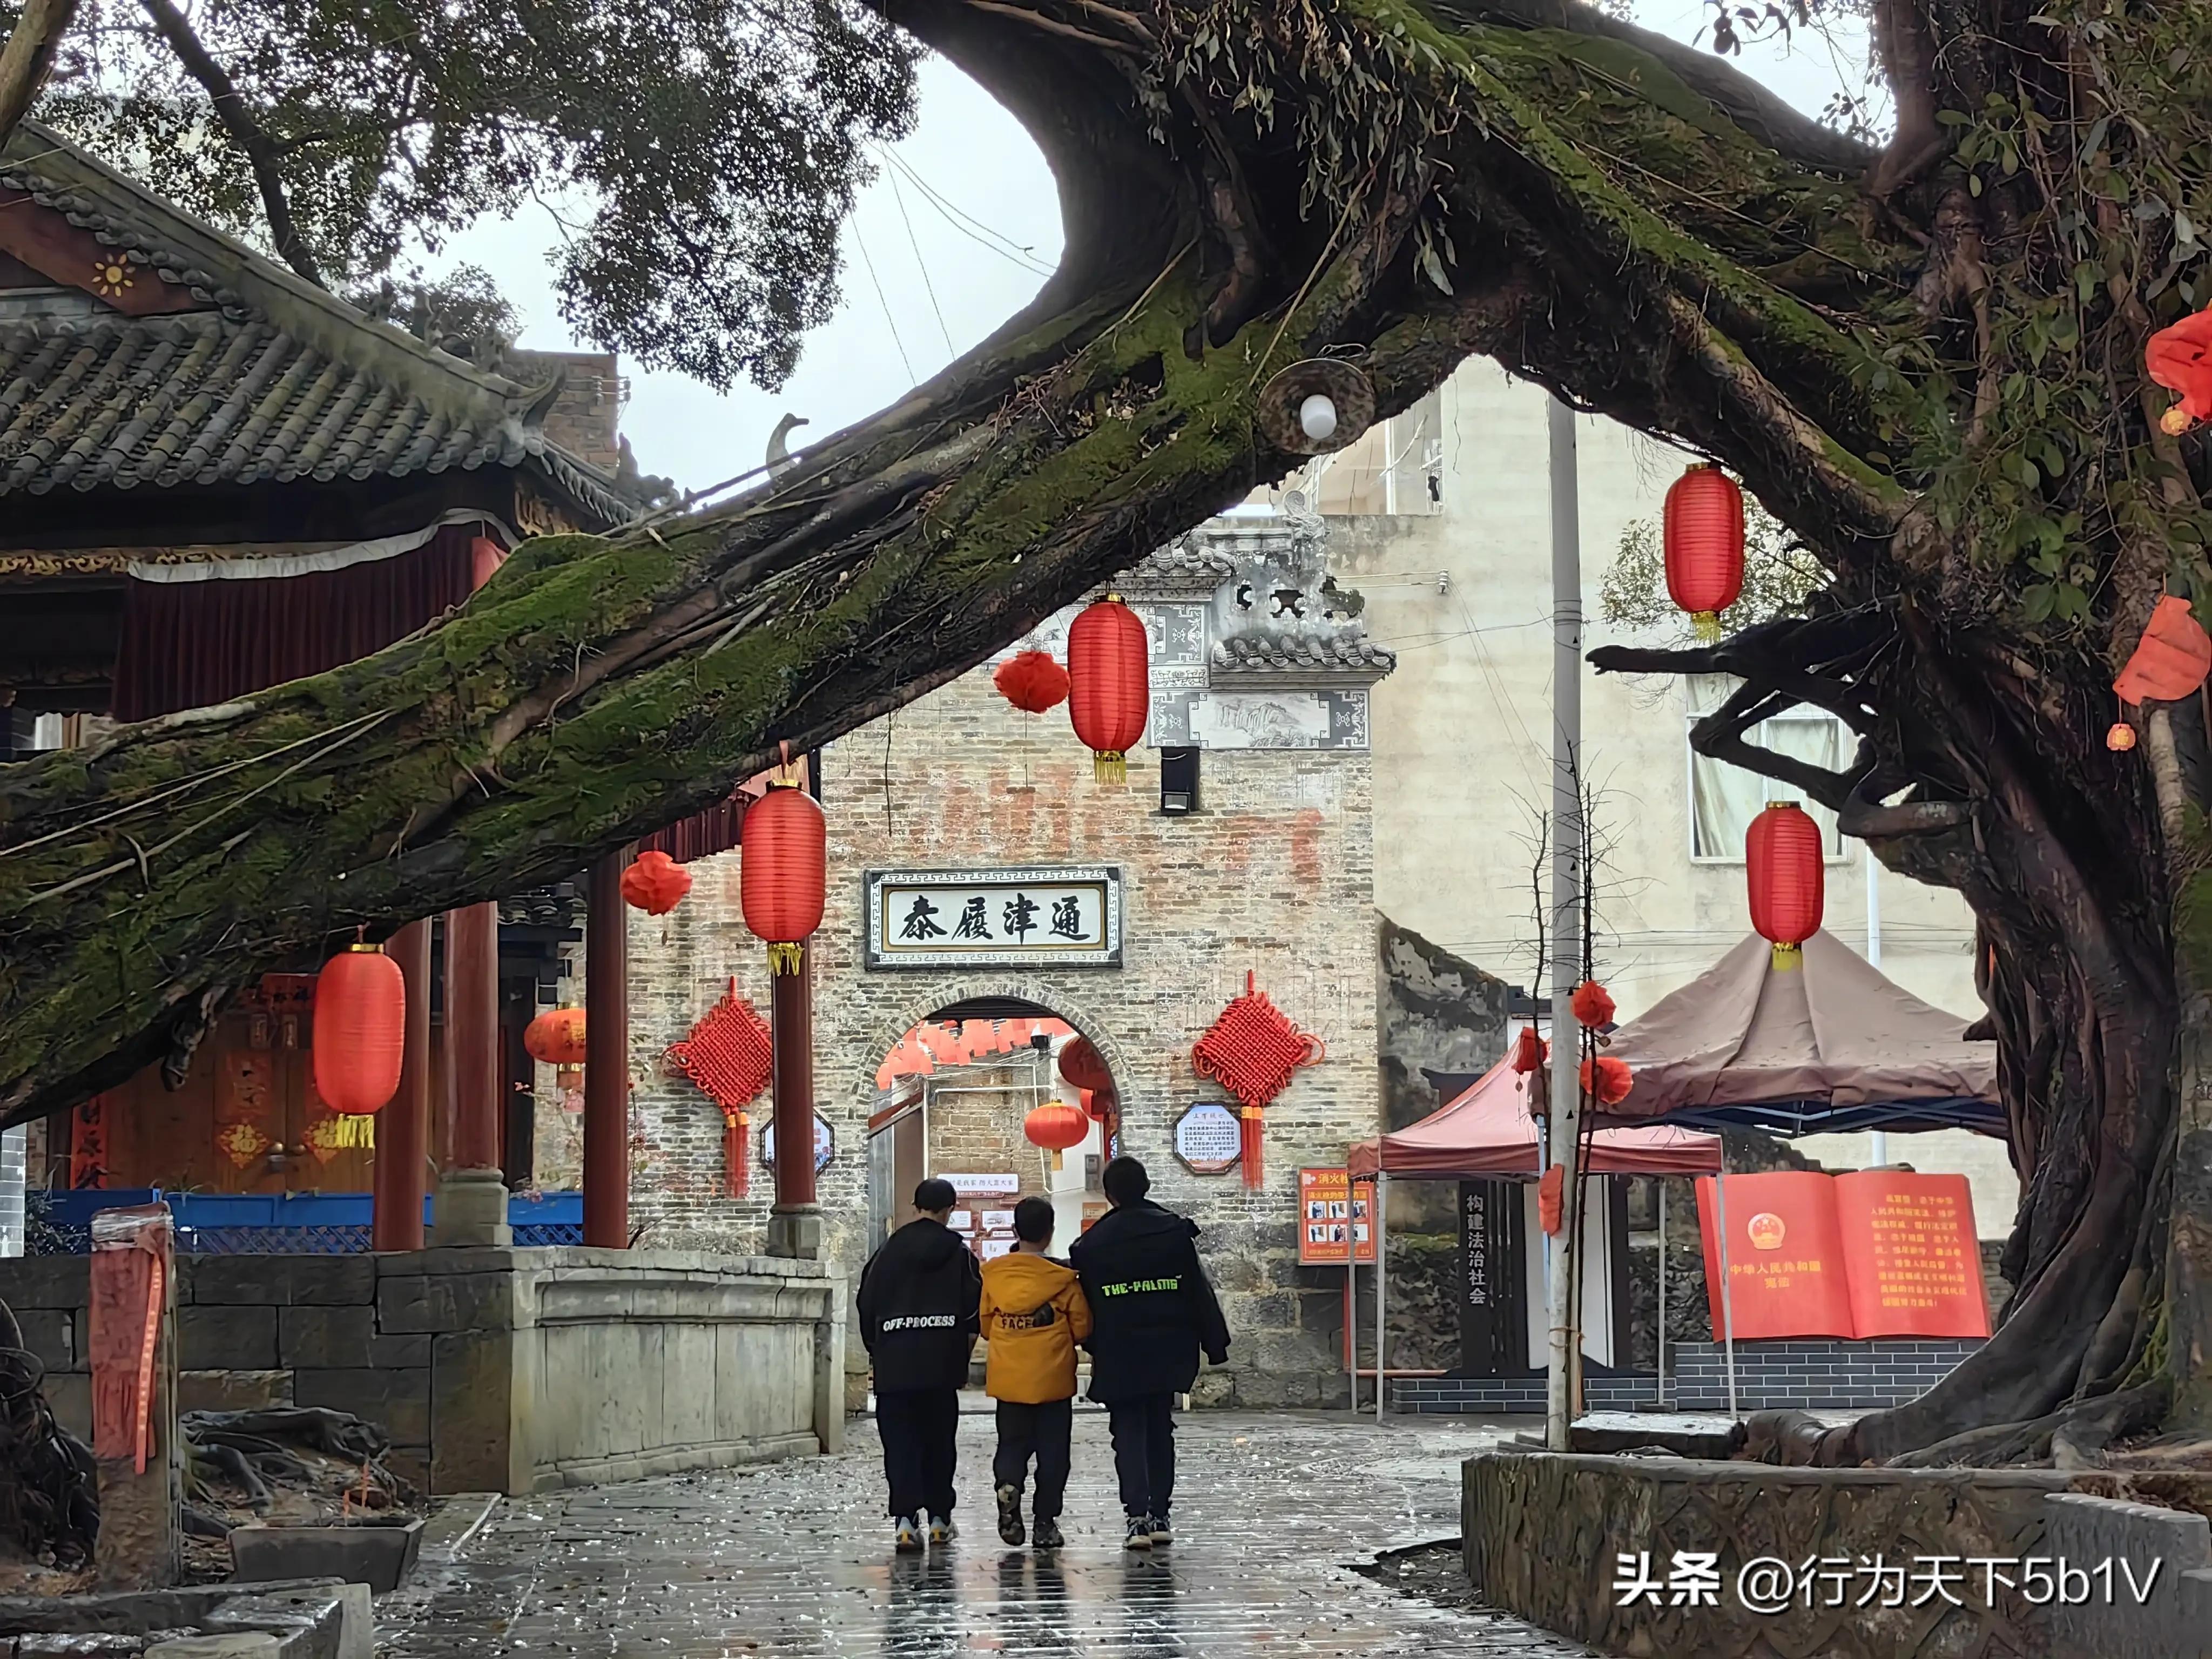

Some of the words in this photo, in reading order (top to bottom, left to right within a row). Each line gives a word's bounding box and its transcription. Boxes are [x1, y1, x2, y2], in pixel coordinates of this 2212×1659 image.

[1466, 1194, 1487, 1304] 构建法治社会
[883, 1315, 955, 1332] OFF-PROCESS
